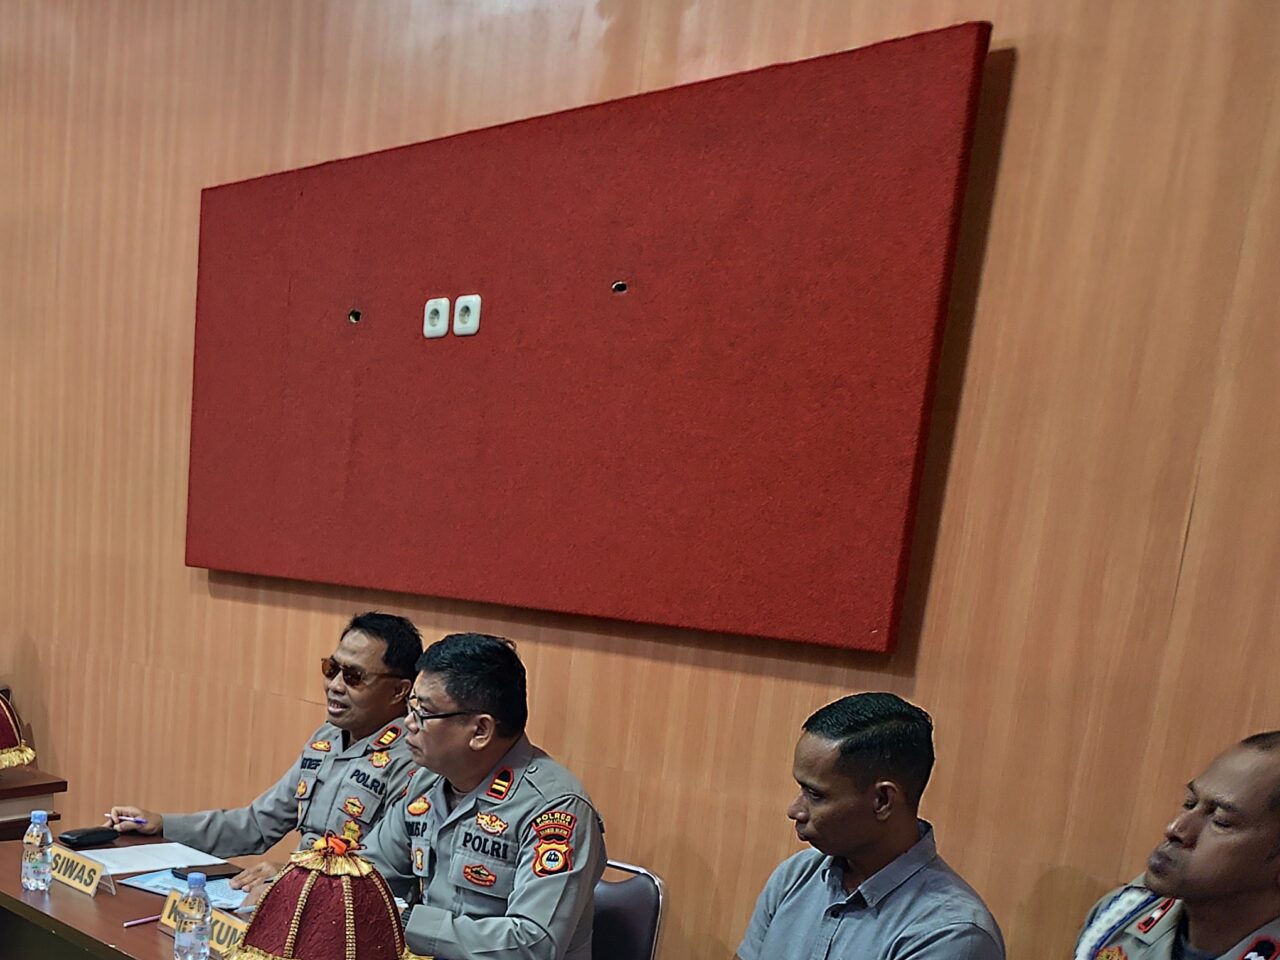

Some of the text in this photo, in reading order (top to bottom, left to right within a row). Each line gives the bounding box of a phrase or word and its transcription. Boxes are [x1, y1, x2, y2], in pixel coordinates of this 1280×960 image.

[350, 769, 385, 795] POLRI
[536, 813, 571, 824] POLRES
[462, 832, 508, 859] POLRI
